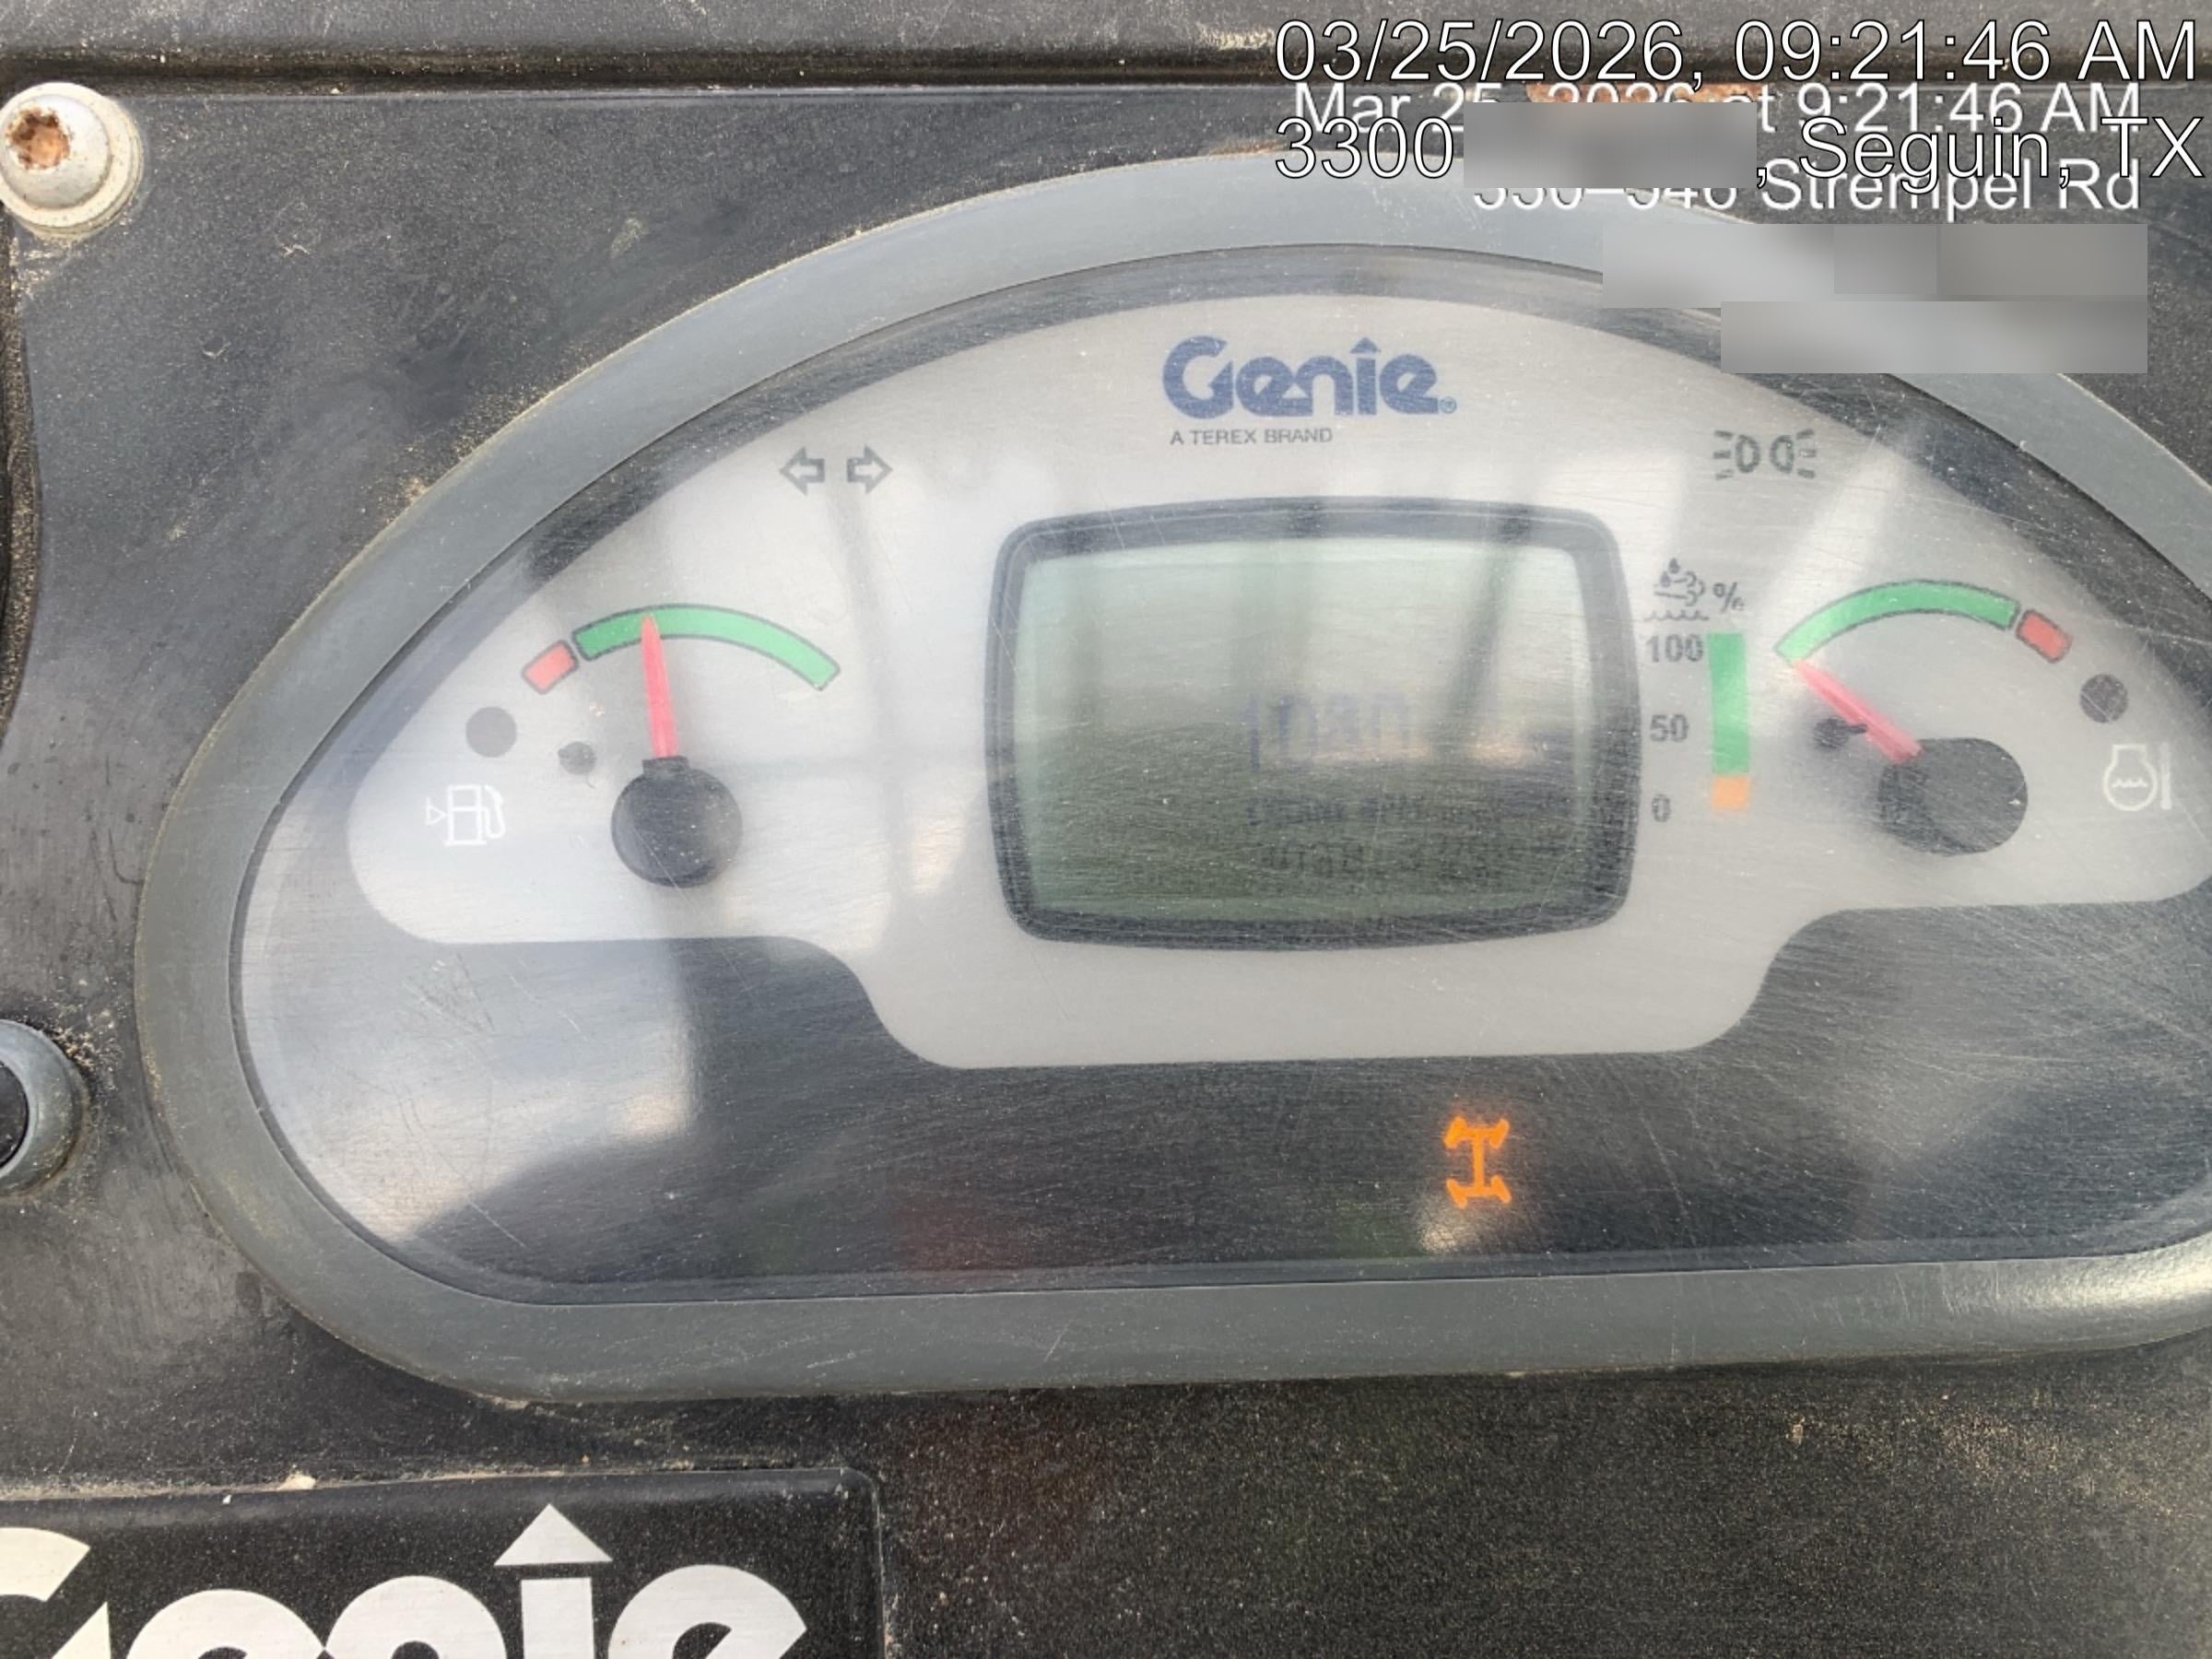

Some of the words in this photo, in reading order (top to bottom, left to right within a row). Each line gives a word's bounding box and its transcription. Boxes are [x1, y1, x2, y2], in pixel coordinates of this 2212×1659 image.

[1163, 335, 1439, 418] Genie
[1170, 430, 1184, 445] A
[1190, 429, 1256, 445] TEREX
[1264, 428, 1333, 443] BRAND
[1647, 633, 1703, 663] 100
[1650, 714, 1688, 743] 50
[1651, 794, 1671, 822] 0
